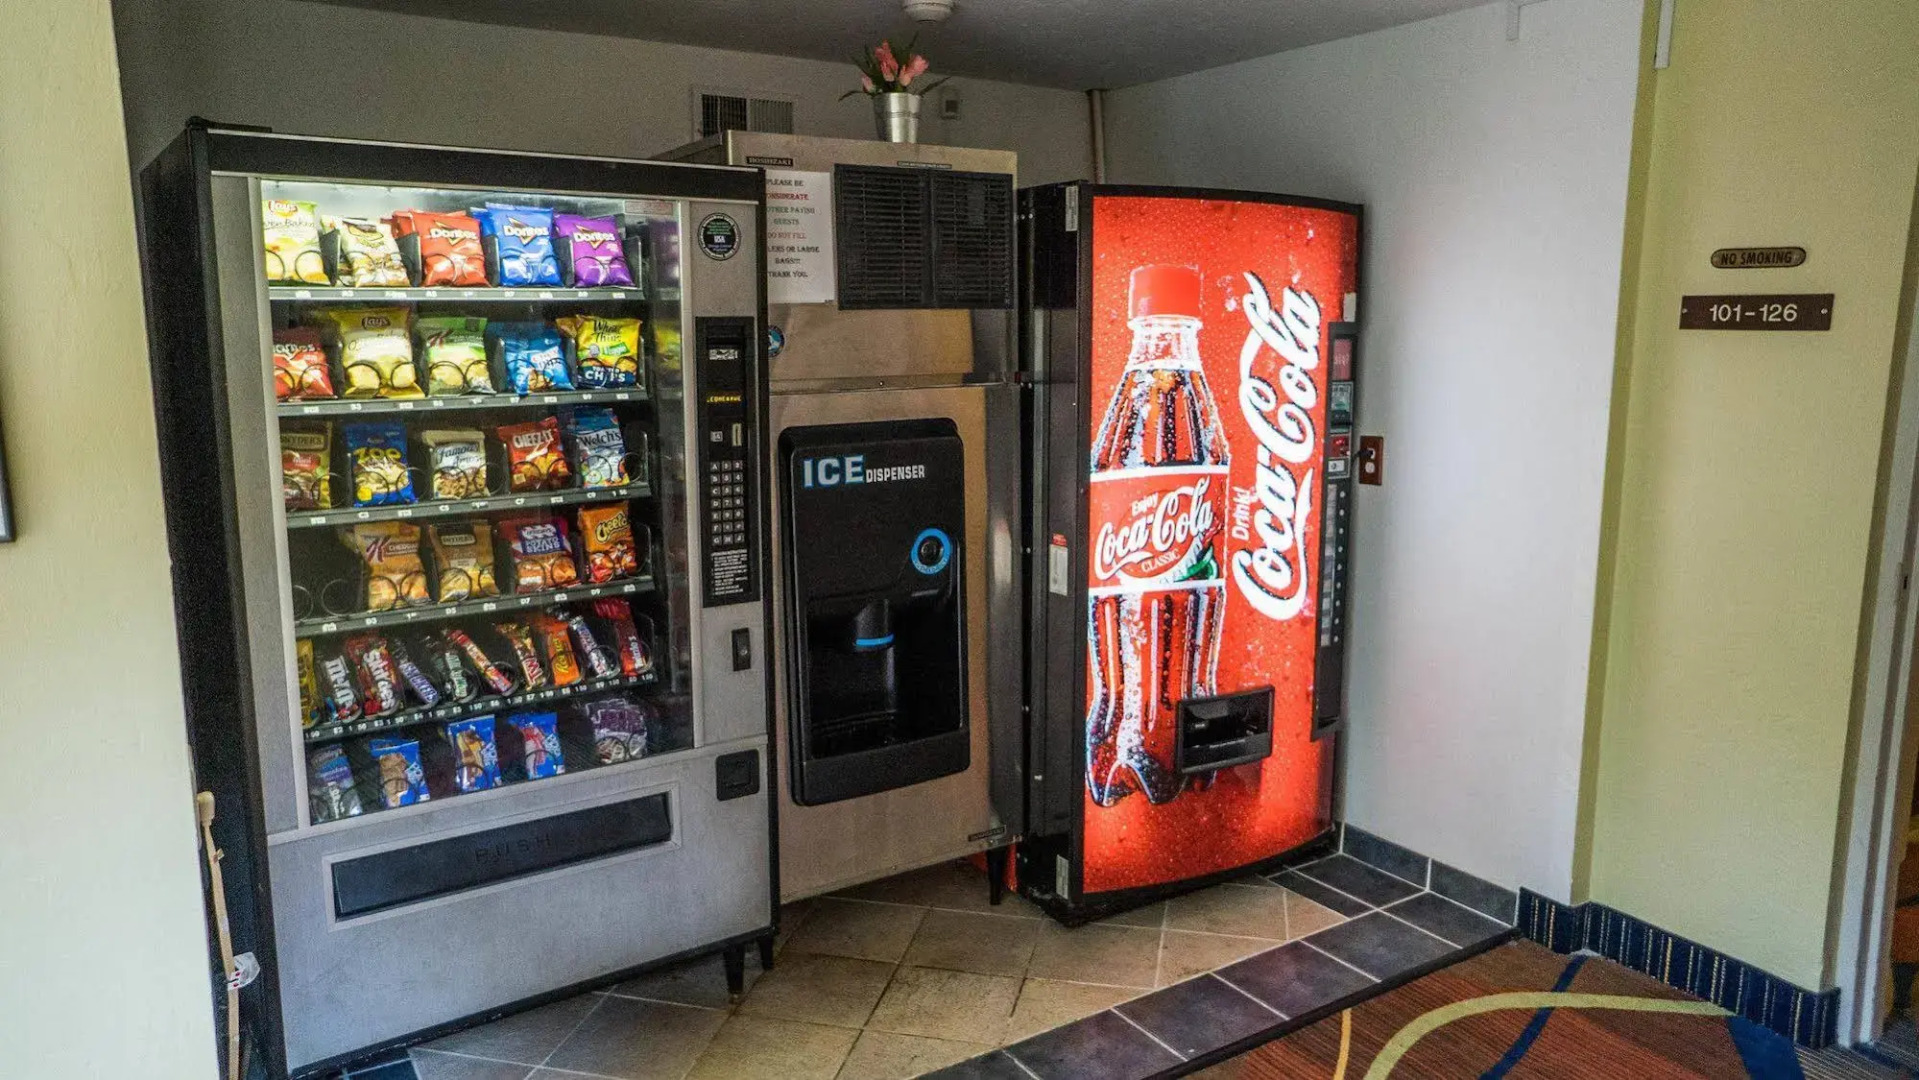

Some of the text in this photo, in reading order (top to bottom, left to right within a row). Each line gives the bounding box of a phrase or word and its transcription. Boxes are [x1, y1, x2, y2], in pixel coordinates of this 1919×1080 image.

[748, 157, 792, 166] HOSHIZAKI
[766, 178, 792, 187] PLEASE
[766, 192, 809, 200] ONSIDERATE
[503, 225, 549, 237] Doritos
[572, 232, 616, 242] Doritos
[1720, 251, 1793, 265] NO SMOKING
[1709, 303, 1798, 322] 101-126
[272, 343, 316, 355] oritos
[580, 429, 621, 446] Welch's
[1232, 271, 1321, 620] Coca-Cola
[802, 454, 926, 488] ICE DISPENSER
[1094, 475, 1214, 580] Coca-Cola
[525, 536, 559, 546] POTATO
[526, 541, 560, 553] SKINS
[1141, 548, 1181, 572] CLASSIC
[363, 649, 395, 711] Skittles
[475, 834, 551, 862] PUSH
